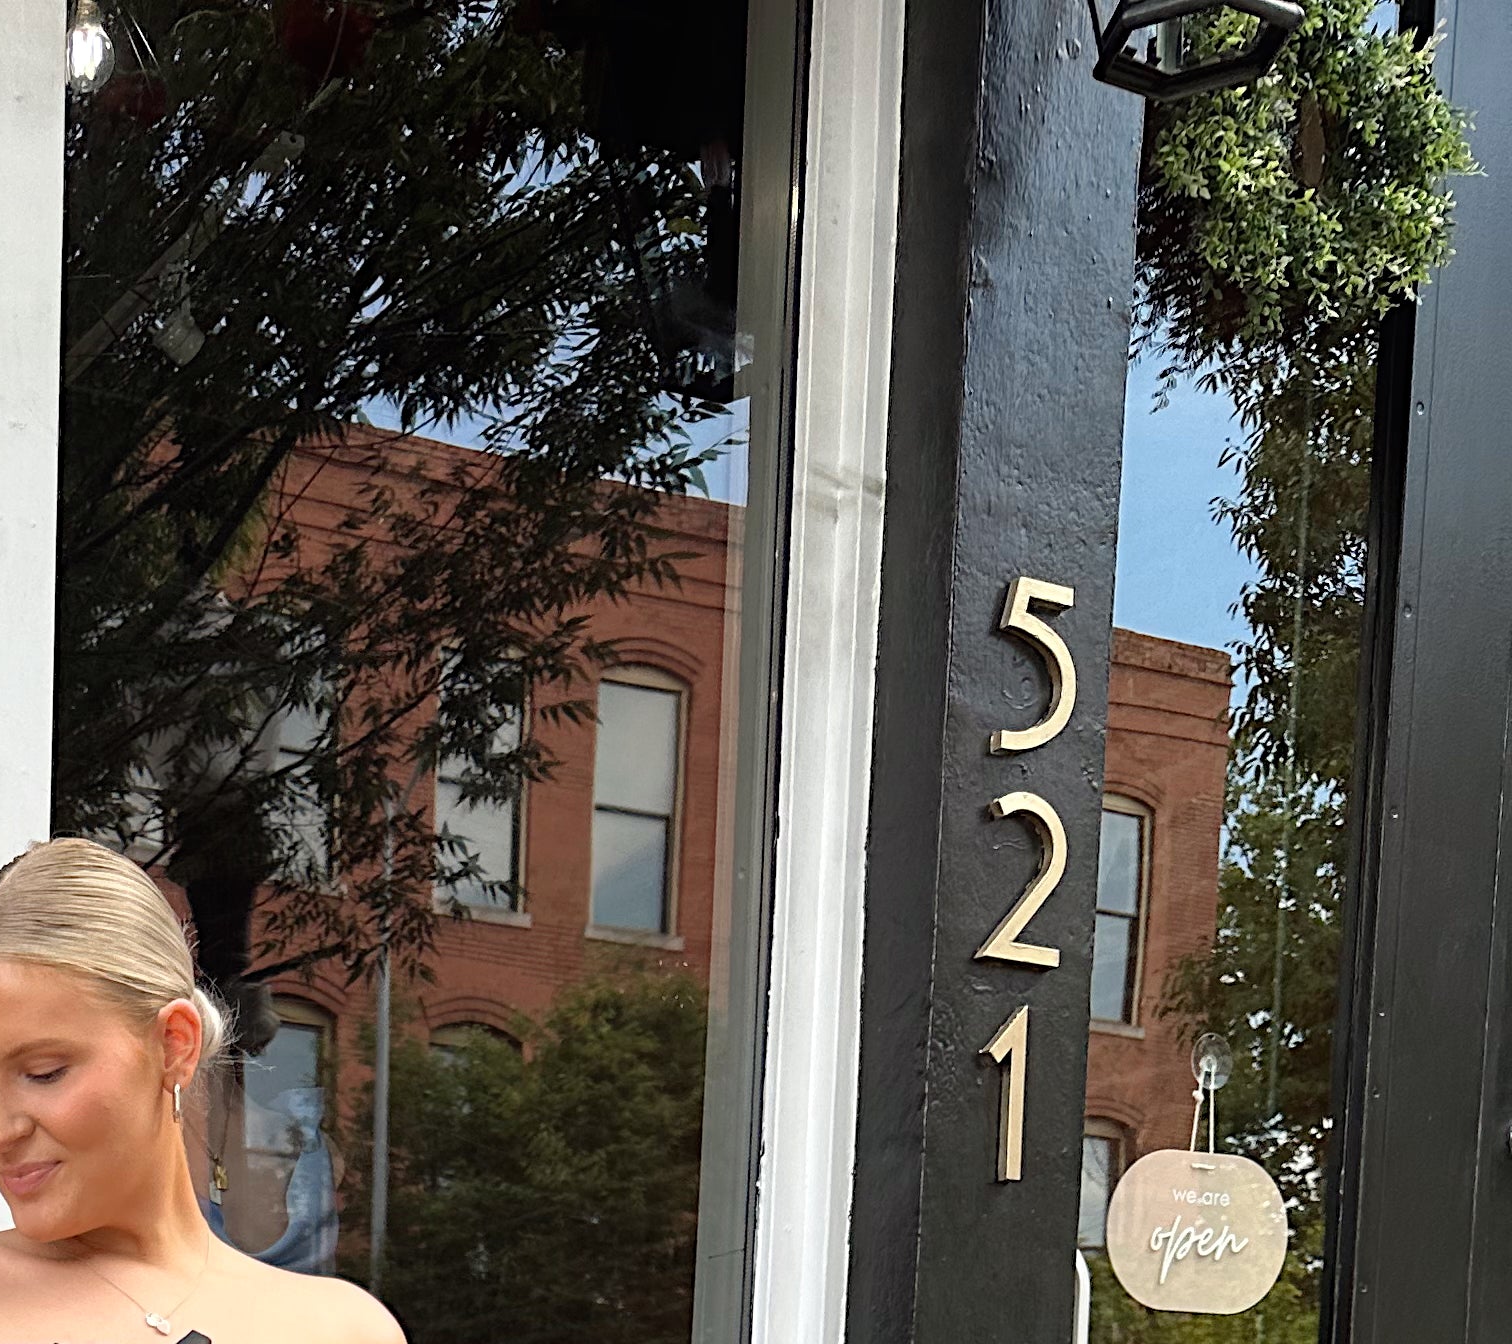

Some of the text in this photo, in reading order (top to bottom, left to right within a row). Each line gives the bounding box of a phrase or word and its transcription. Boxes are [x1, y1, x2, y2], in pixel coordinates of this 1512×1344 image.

[974, 575, 1078, 1182] 521
[1173, 1189, 1230, 1206] we are
[1150, 1215, 1249, 1284] open
